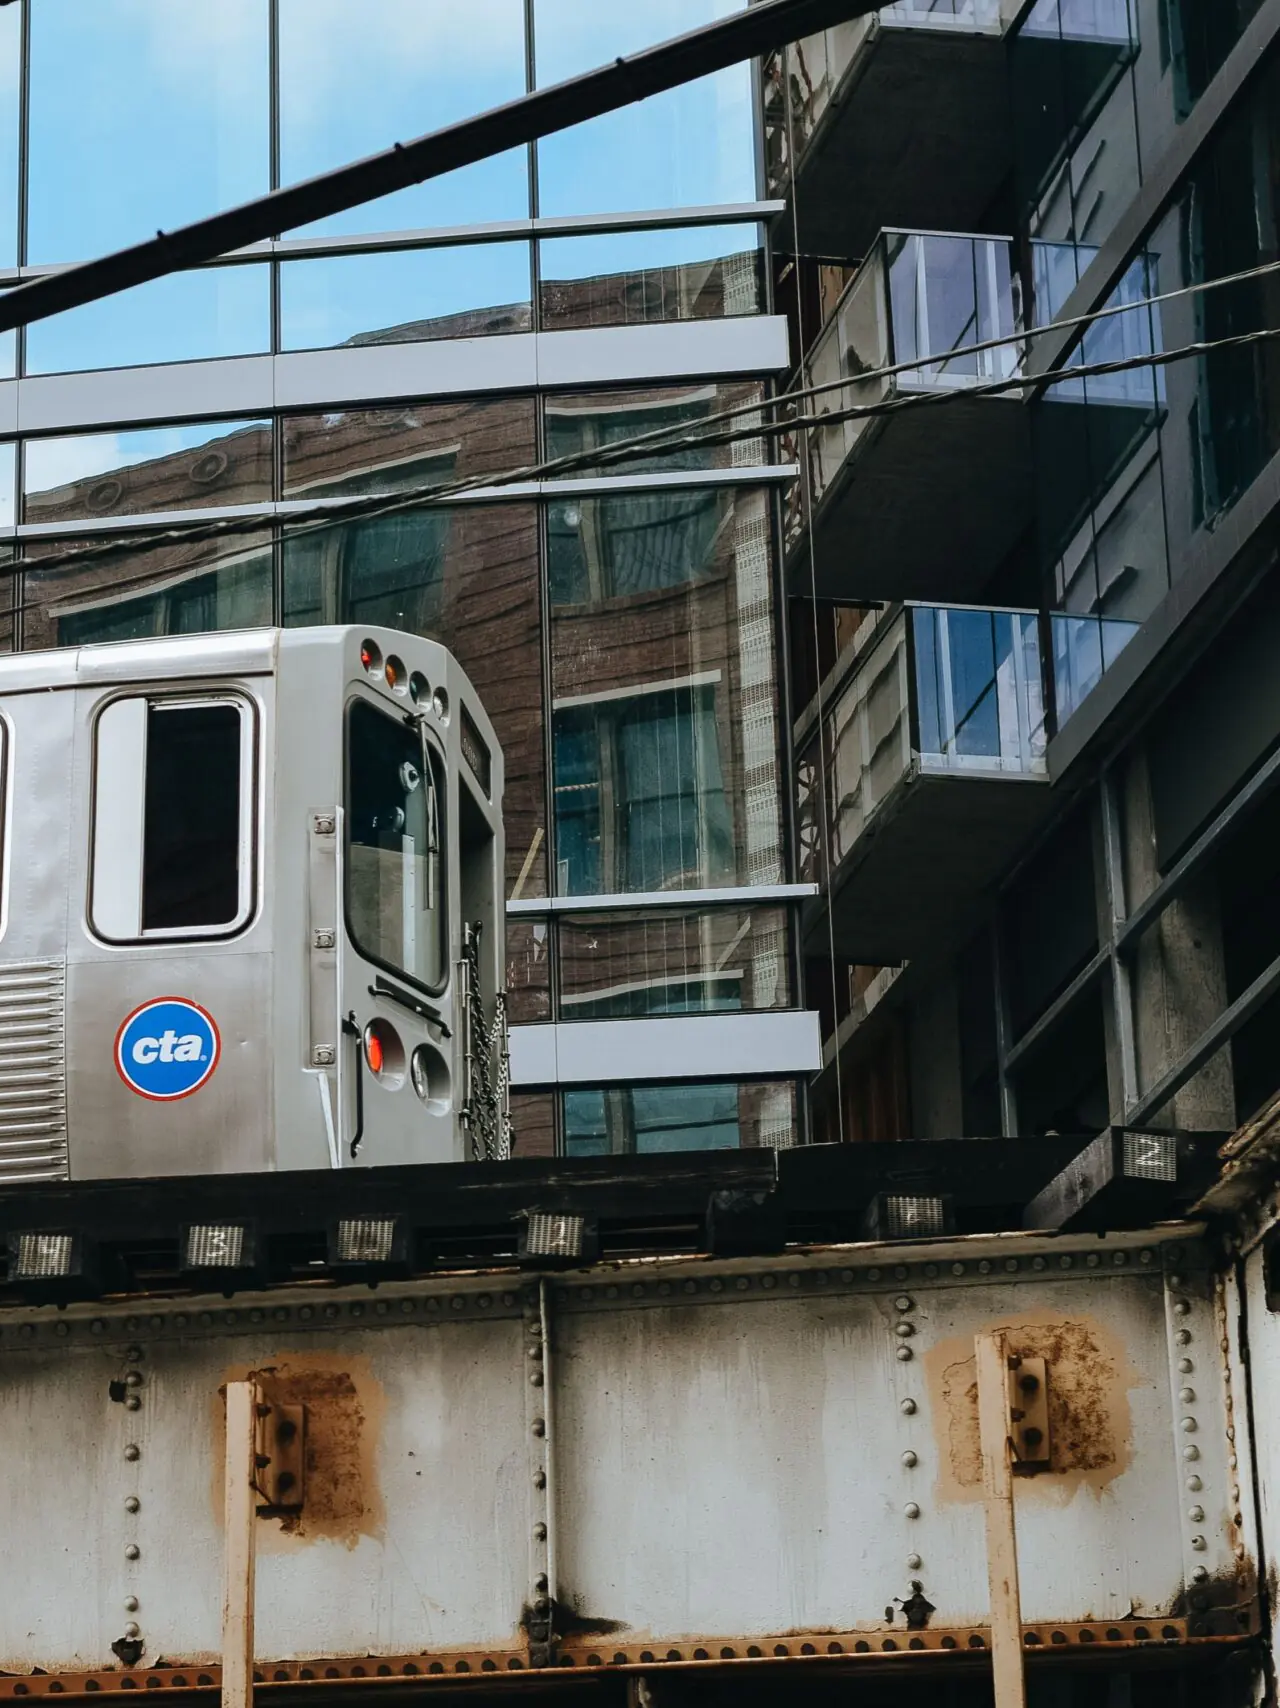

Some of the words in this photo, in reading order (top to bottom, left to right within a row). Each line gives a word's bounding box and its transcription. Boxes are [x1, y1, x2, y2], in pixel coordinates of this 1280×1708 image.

[132, 1030, 204, 1065] cta
[1135, 1138, 1164, 1167] 2
[207, 1230, 230, 1258] 3
